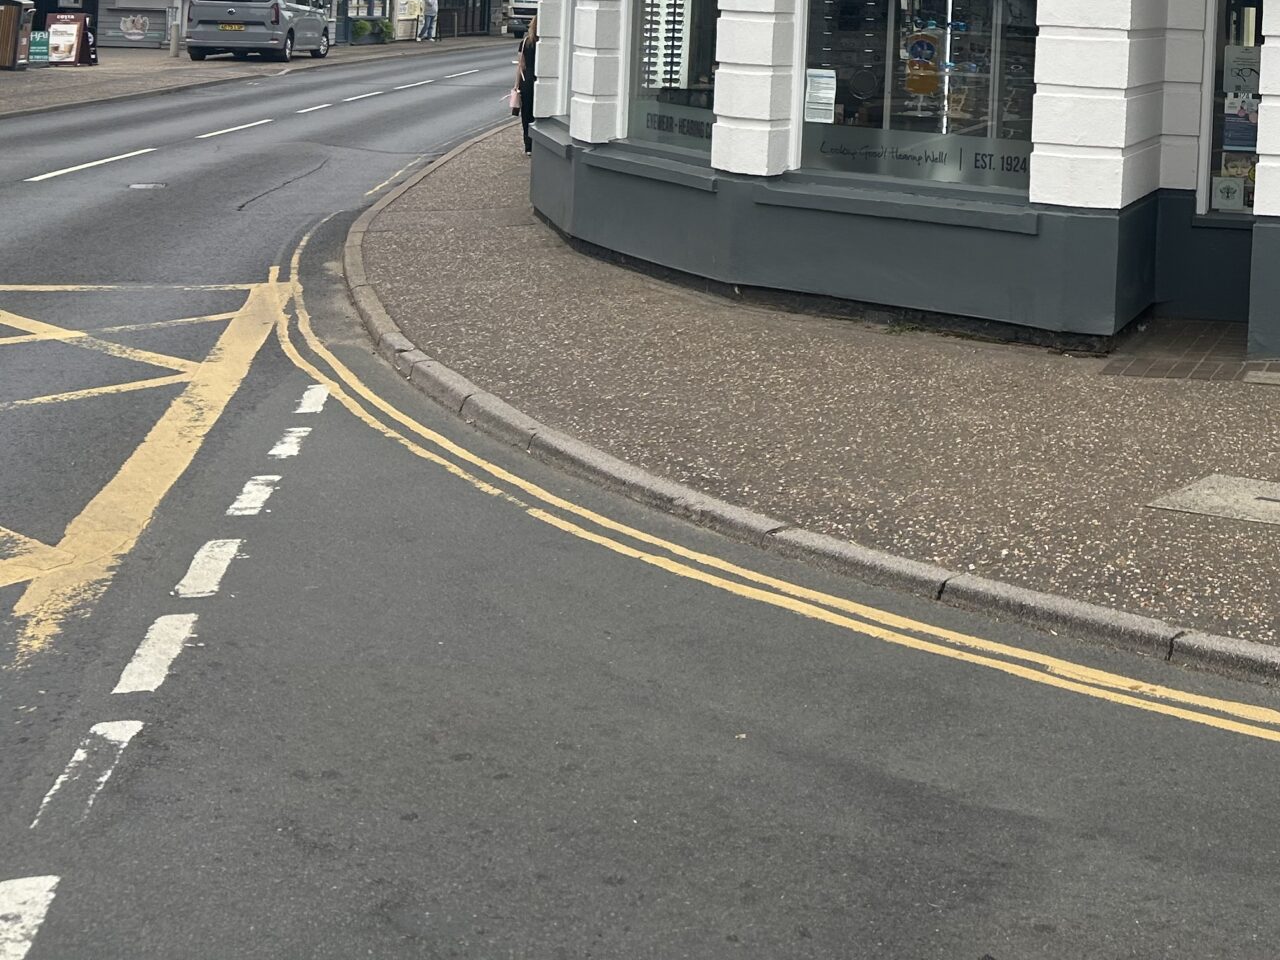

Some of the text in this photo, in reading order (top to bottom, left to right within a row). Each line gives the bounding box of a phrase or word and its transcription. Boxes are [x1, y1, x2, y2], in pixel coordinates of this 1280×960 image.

[819, 141, 856, 160] Looking
[890, 148, 922, 166] Hearing
[974, 152, 996, 171] EST.
[1000, 154, 1028, 174] 1924
